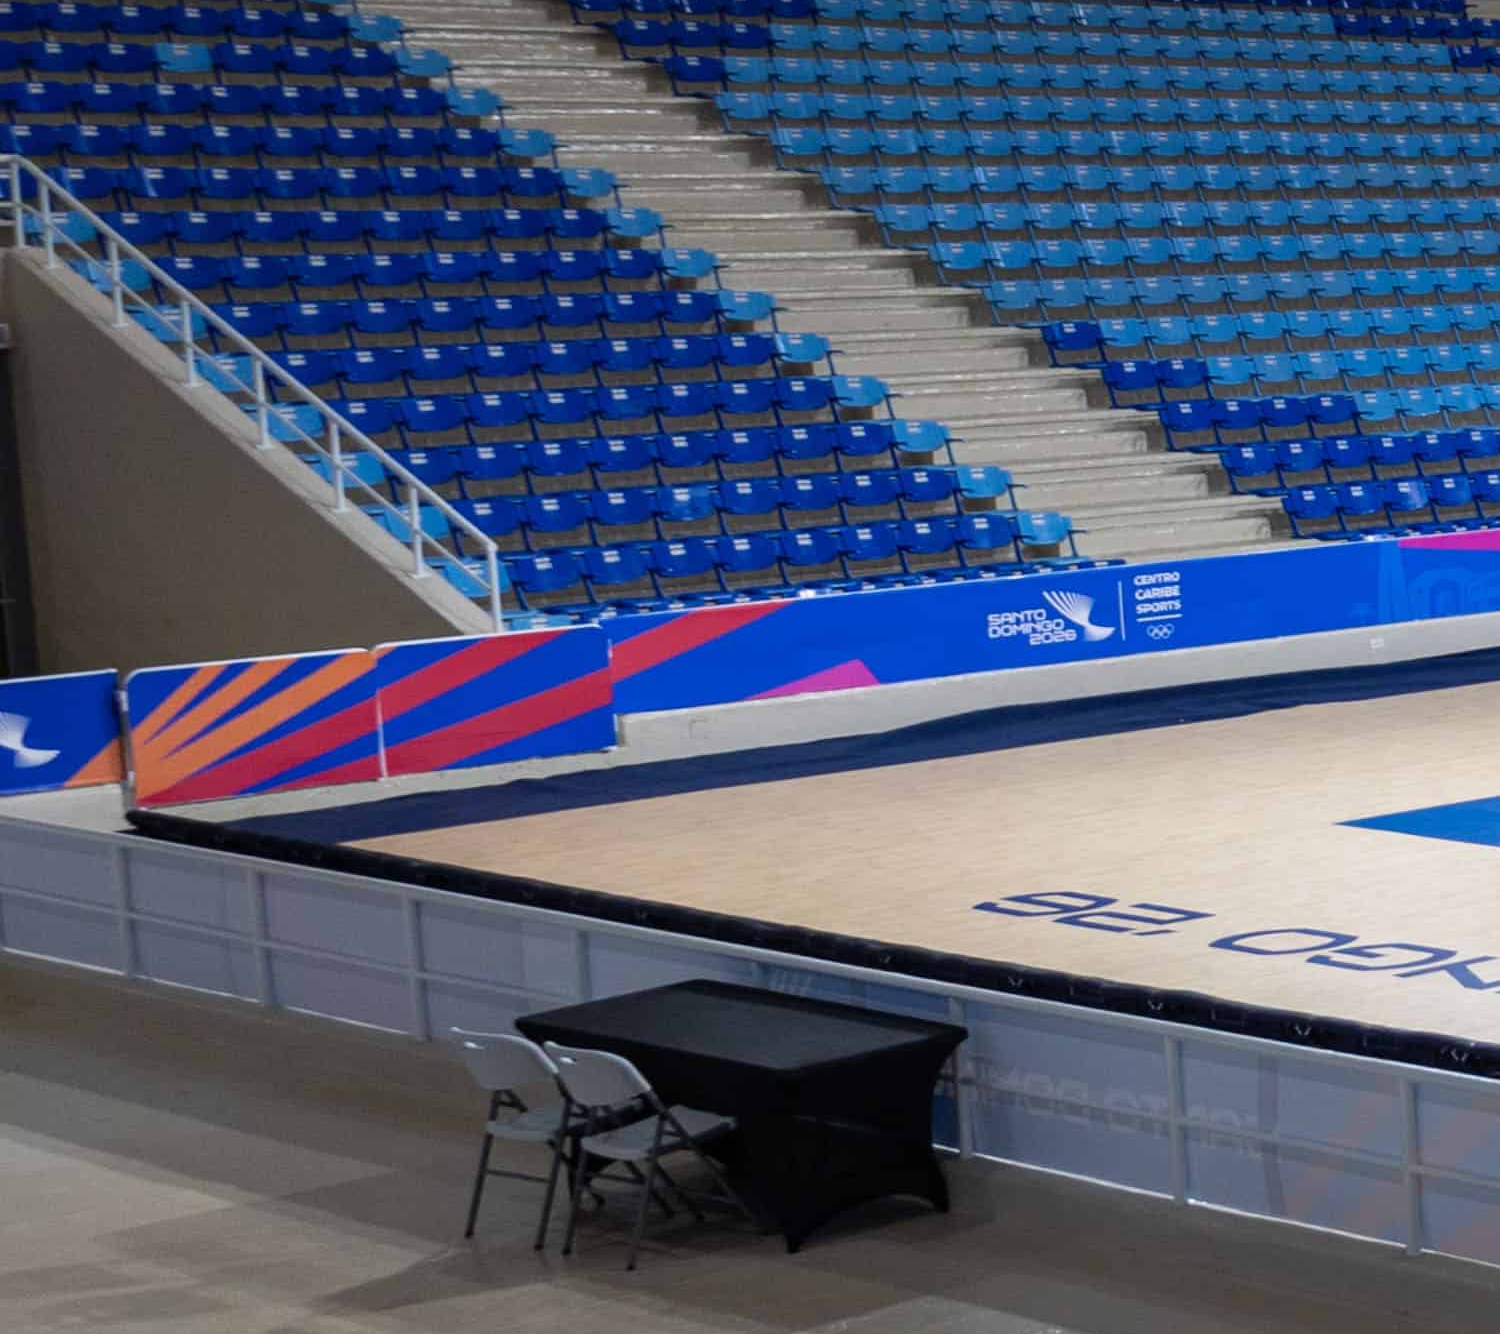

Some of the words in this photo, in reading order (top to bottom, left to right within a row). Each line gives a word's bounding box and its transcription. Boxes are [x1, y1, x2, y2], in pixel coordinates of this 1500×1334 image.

[1133, 571, 1182, 586] CENTRO
[1134, 585, 1182, 600] CARIBE
[1136, 599, 1183, 615] SPORTS
[987, 608, 1047, 627] SANTO
[987, 618, 1065, 639] DOMINGO
[973, 890, 1214, 937] '26
